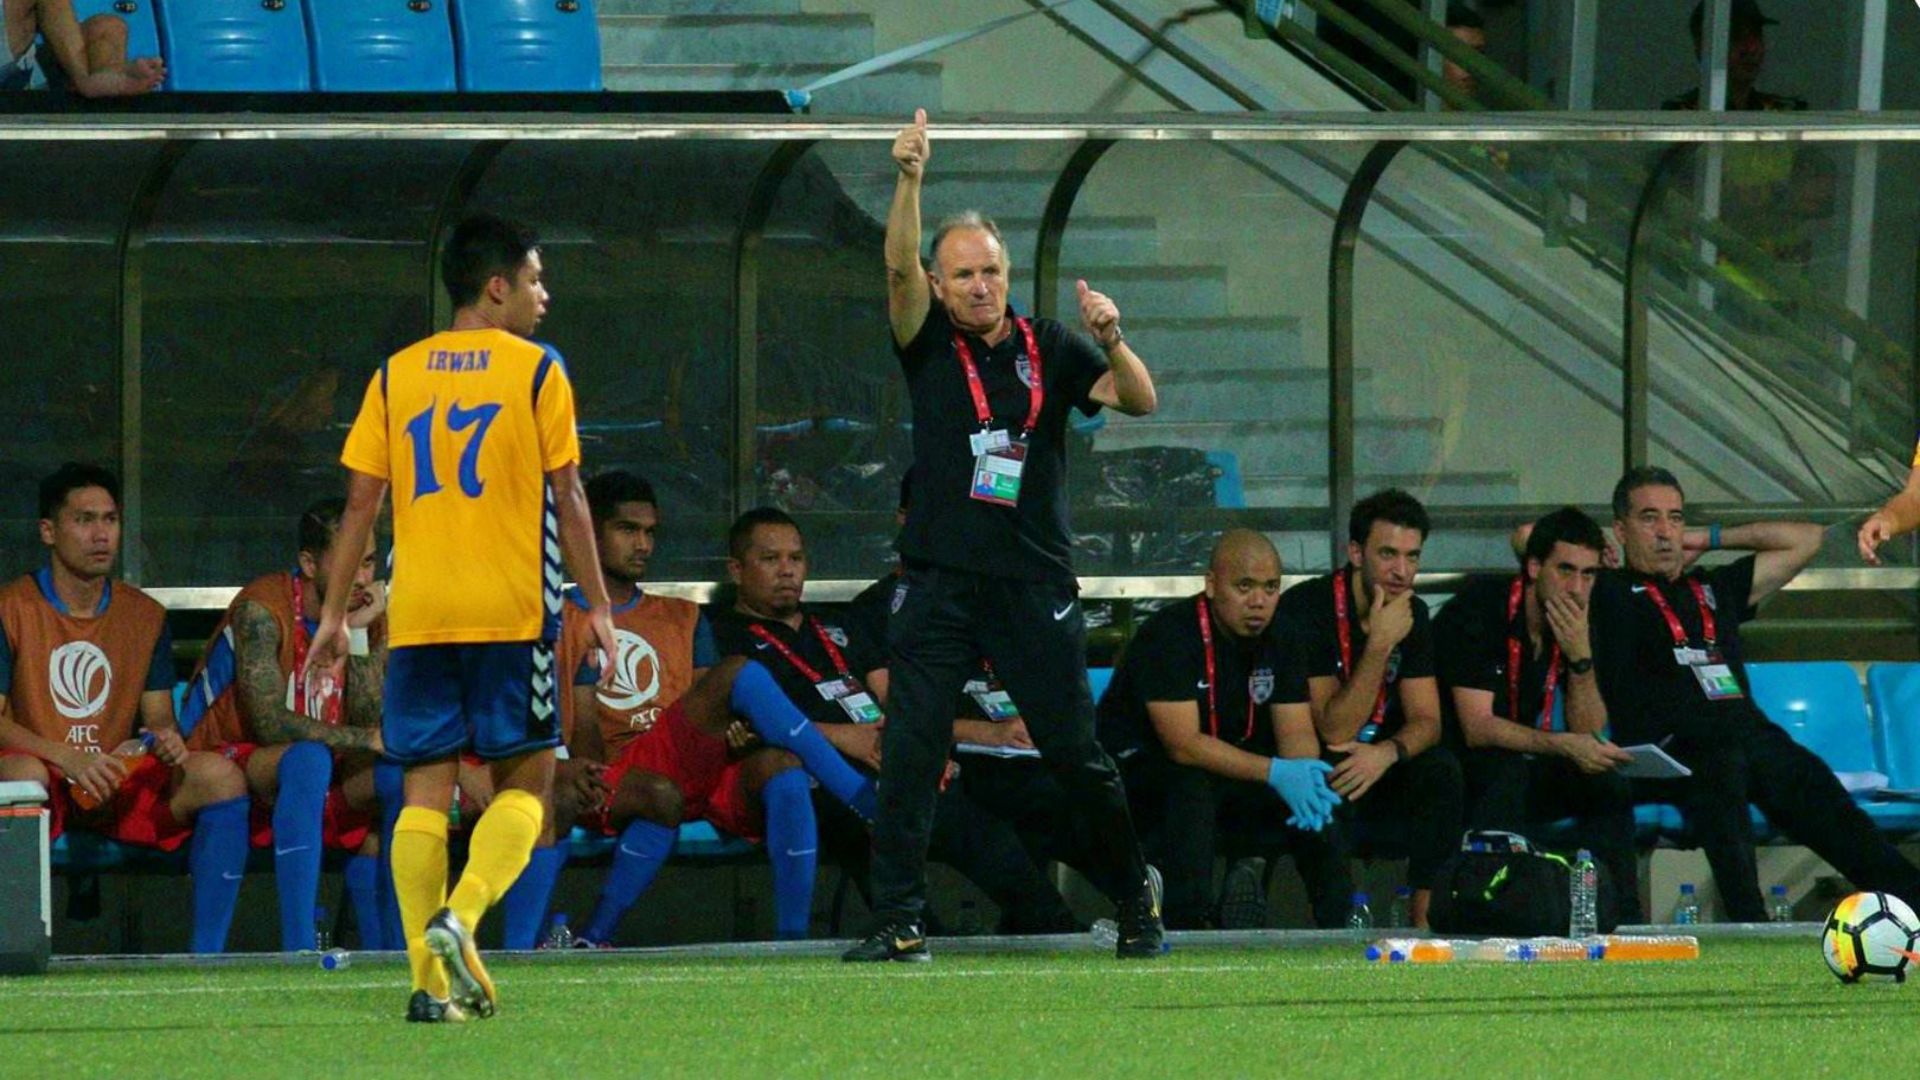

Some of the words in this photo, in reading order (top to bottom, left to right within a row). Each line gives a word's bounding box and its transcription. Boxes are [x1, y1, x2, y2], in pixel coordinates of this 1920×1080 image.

[427, 349, 491, 372] IRWAN
[402, 394, 503, 506] 17
[64, 724, 99, 743] AFC
